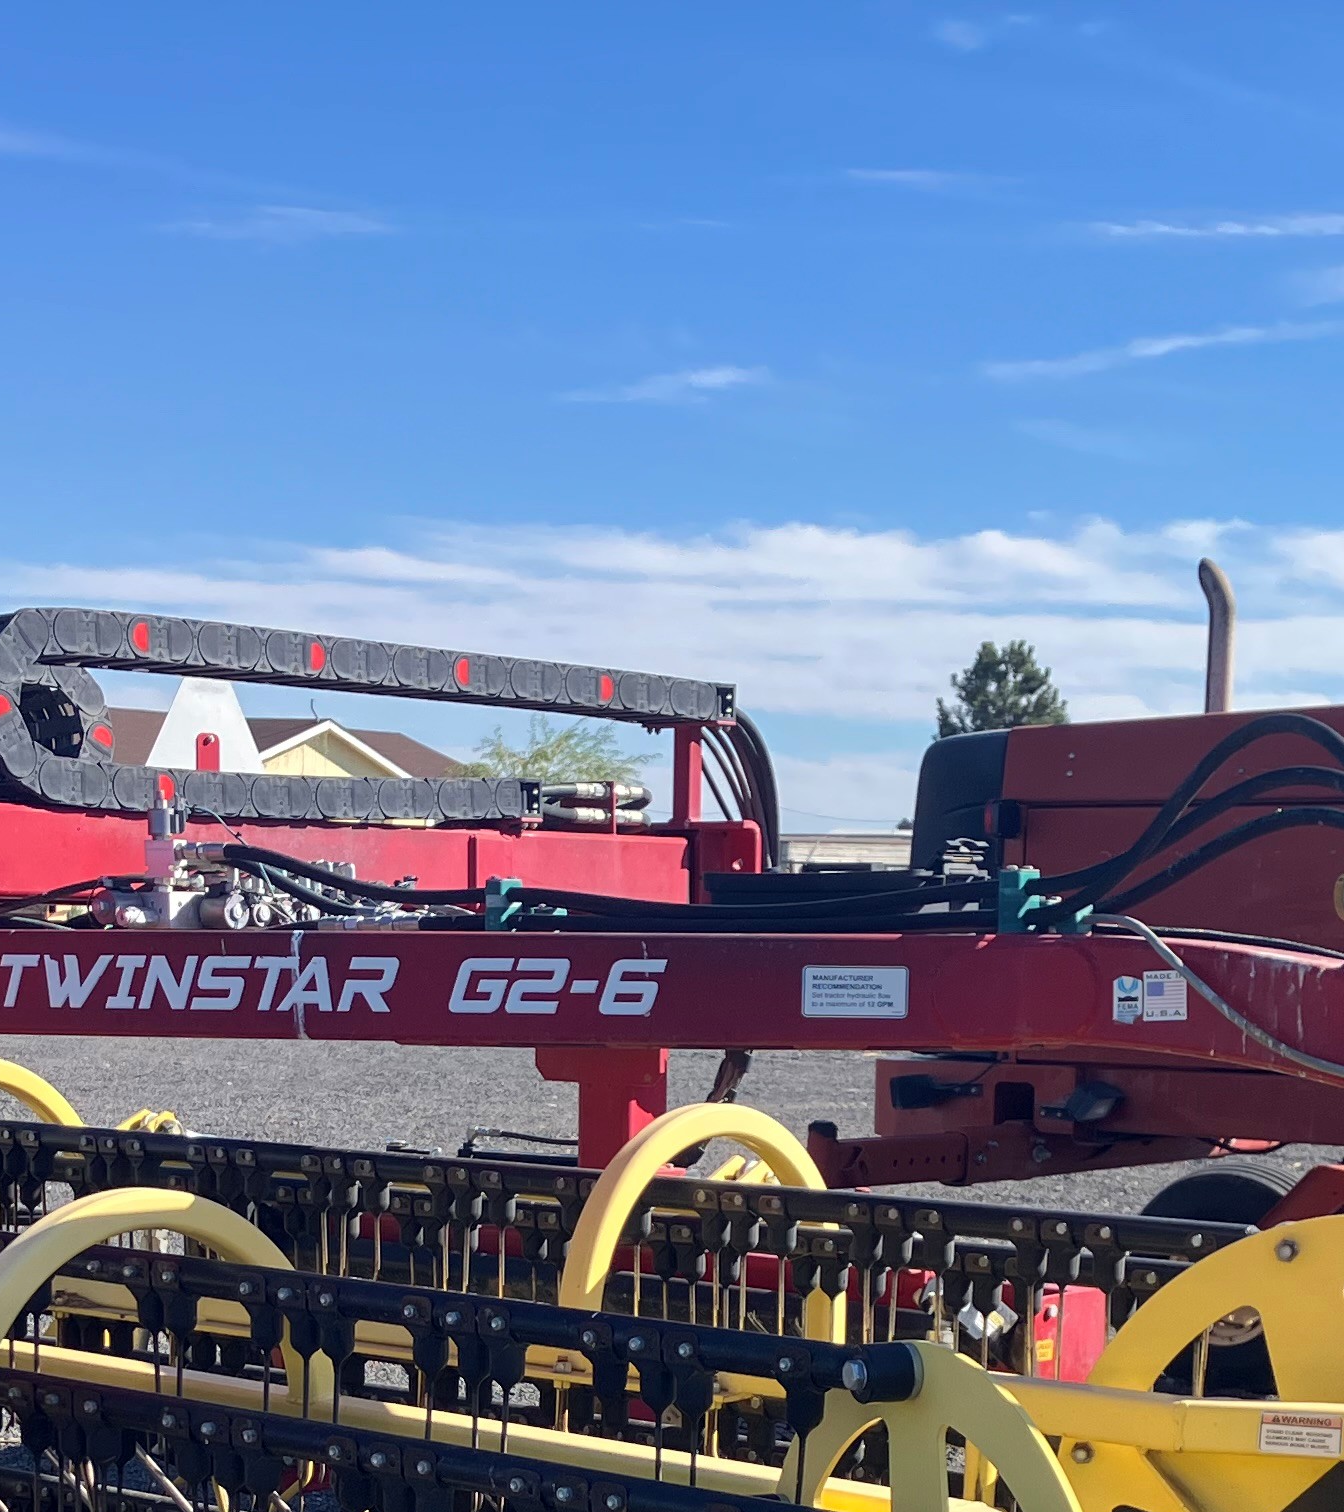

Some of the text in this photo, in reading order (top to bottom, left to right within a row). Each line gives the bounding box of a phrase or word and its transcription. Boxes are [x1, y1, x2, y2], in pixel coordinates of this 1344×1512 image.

[812, 974, 874, 982] MANUFACTURER
[1, 953, 668, 1016] TWINSTAR G2-6
[812, 983, 883, 991] RECOMMENDATION
[846, 992, 876, 1000] hydraulic
[1145, 1009, 1186, 1018] U.S.A.
[1281, 1415, 1332, 1427] WARNING
